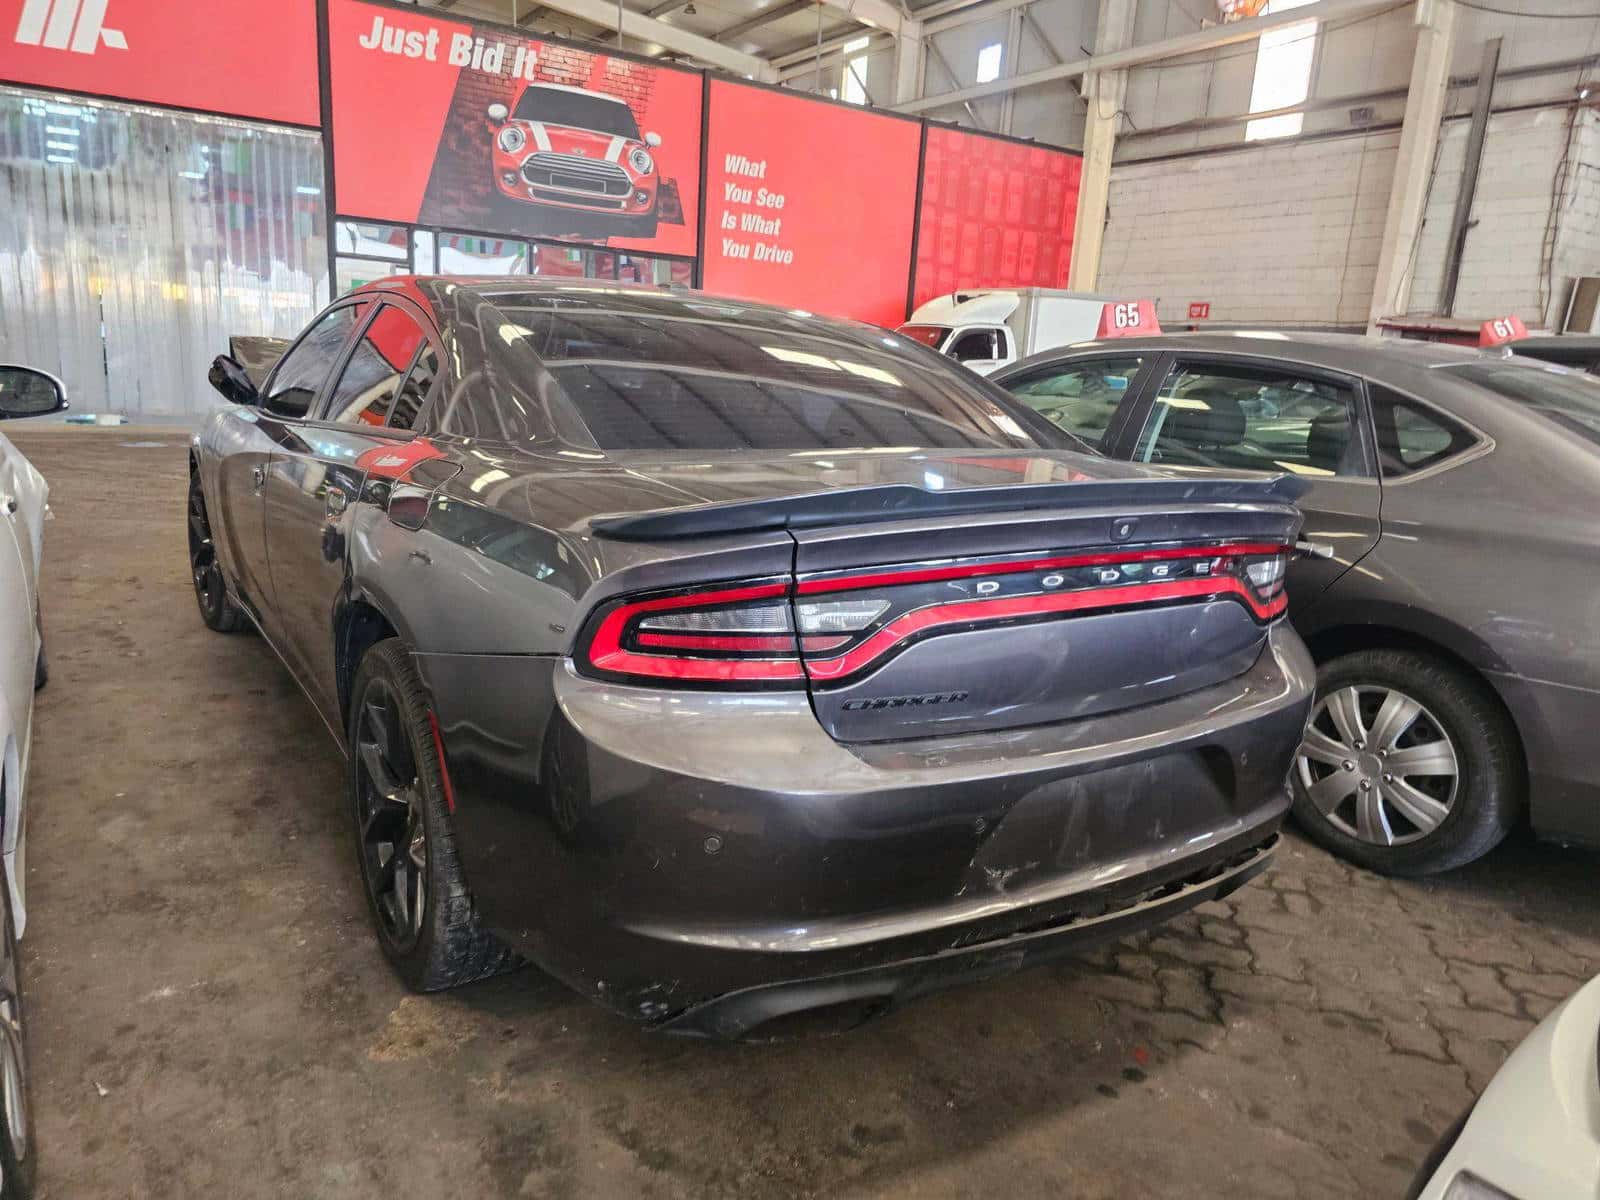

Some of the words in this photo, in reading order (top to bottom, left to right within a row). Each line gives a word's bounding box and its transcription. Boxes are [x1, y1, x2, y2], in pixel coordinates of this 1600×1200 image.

[359, 15, 439, 61] Just
[448, 32, 506, 74] Bid
[512, 46, 538, 81] It
[724, 153, 767, 179] What
[723, 182, 753, 204] You
[755, 187, 785, 208] See
[721, 210, 737, 230] Is
[740, 213, 781, 236] What
[721, 238, 751, 259] You
[753, 242, 793, 264] Drive
[1115, 303, 1139, 328] 65
[976, 562, 1211, 593] DODGE
